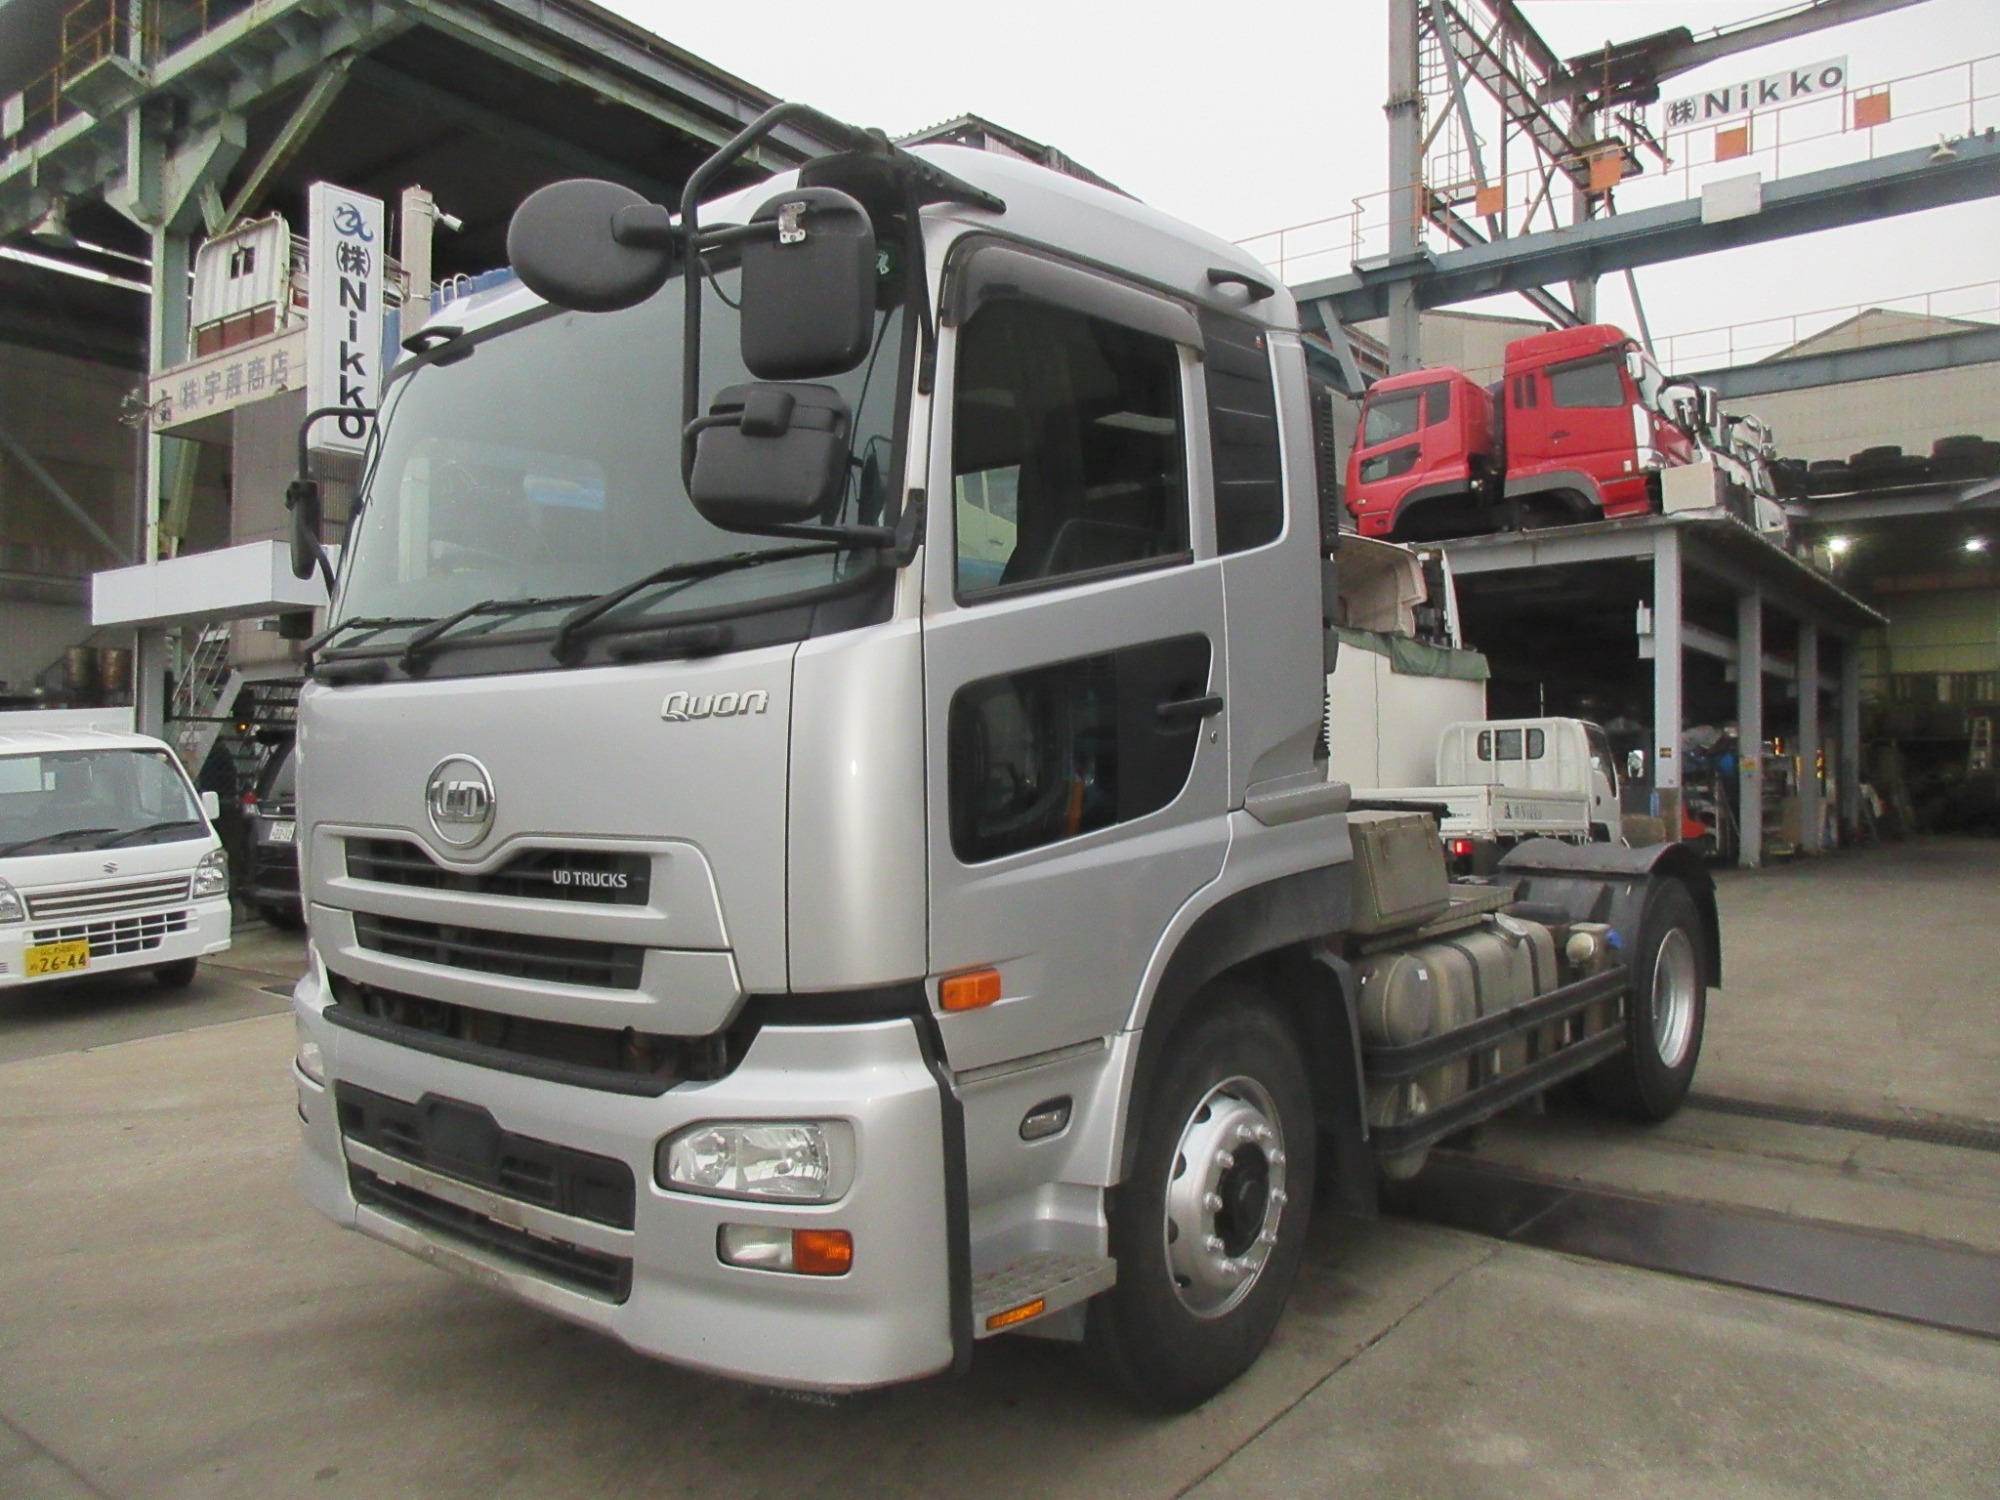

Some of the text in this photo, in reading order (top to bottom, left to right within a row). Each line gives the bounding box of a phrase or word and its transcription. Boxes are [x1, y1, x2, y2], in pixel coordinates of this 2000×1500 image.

[660, 690, 769, 722] Quon
[429, 780, 489, 823] UD
[553, 870, 628, 888] UD TRUCKS
[40, 952, 87, 972] 26-44
